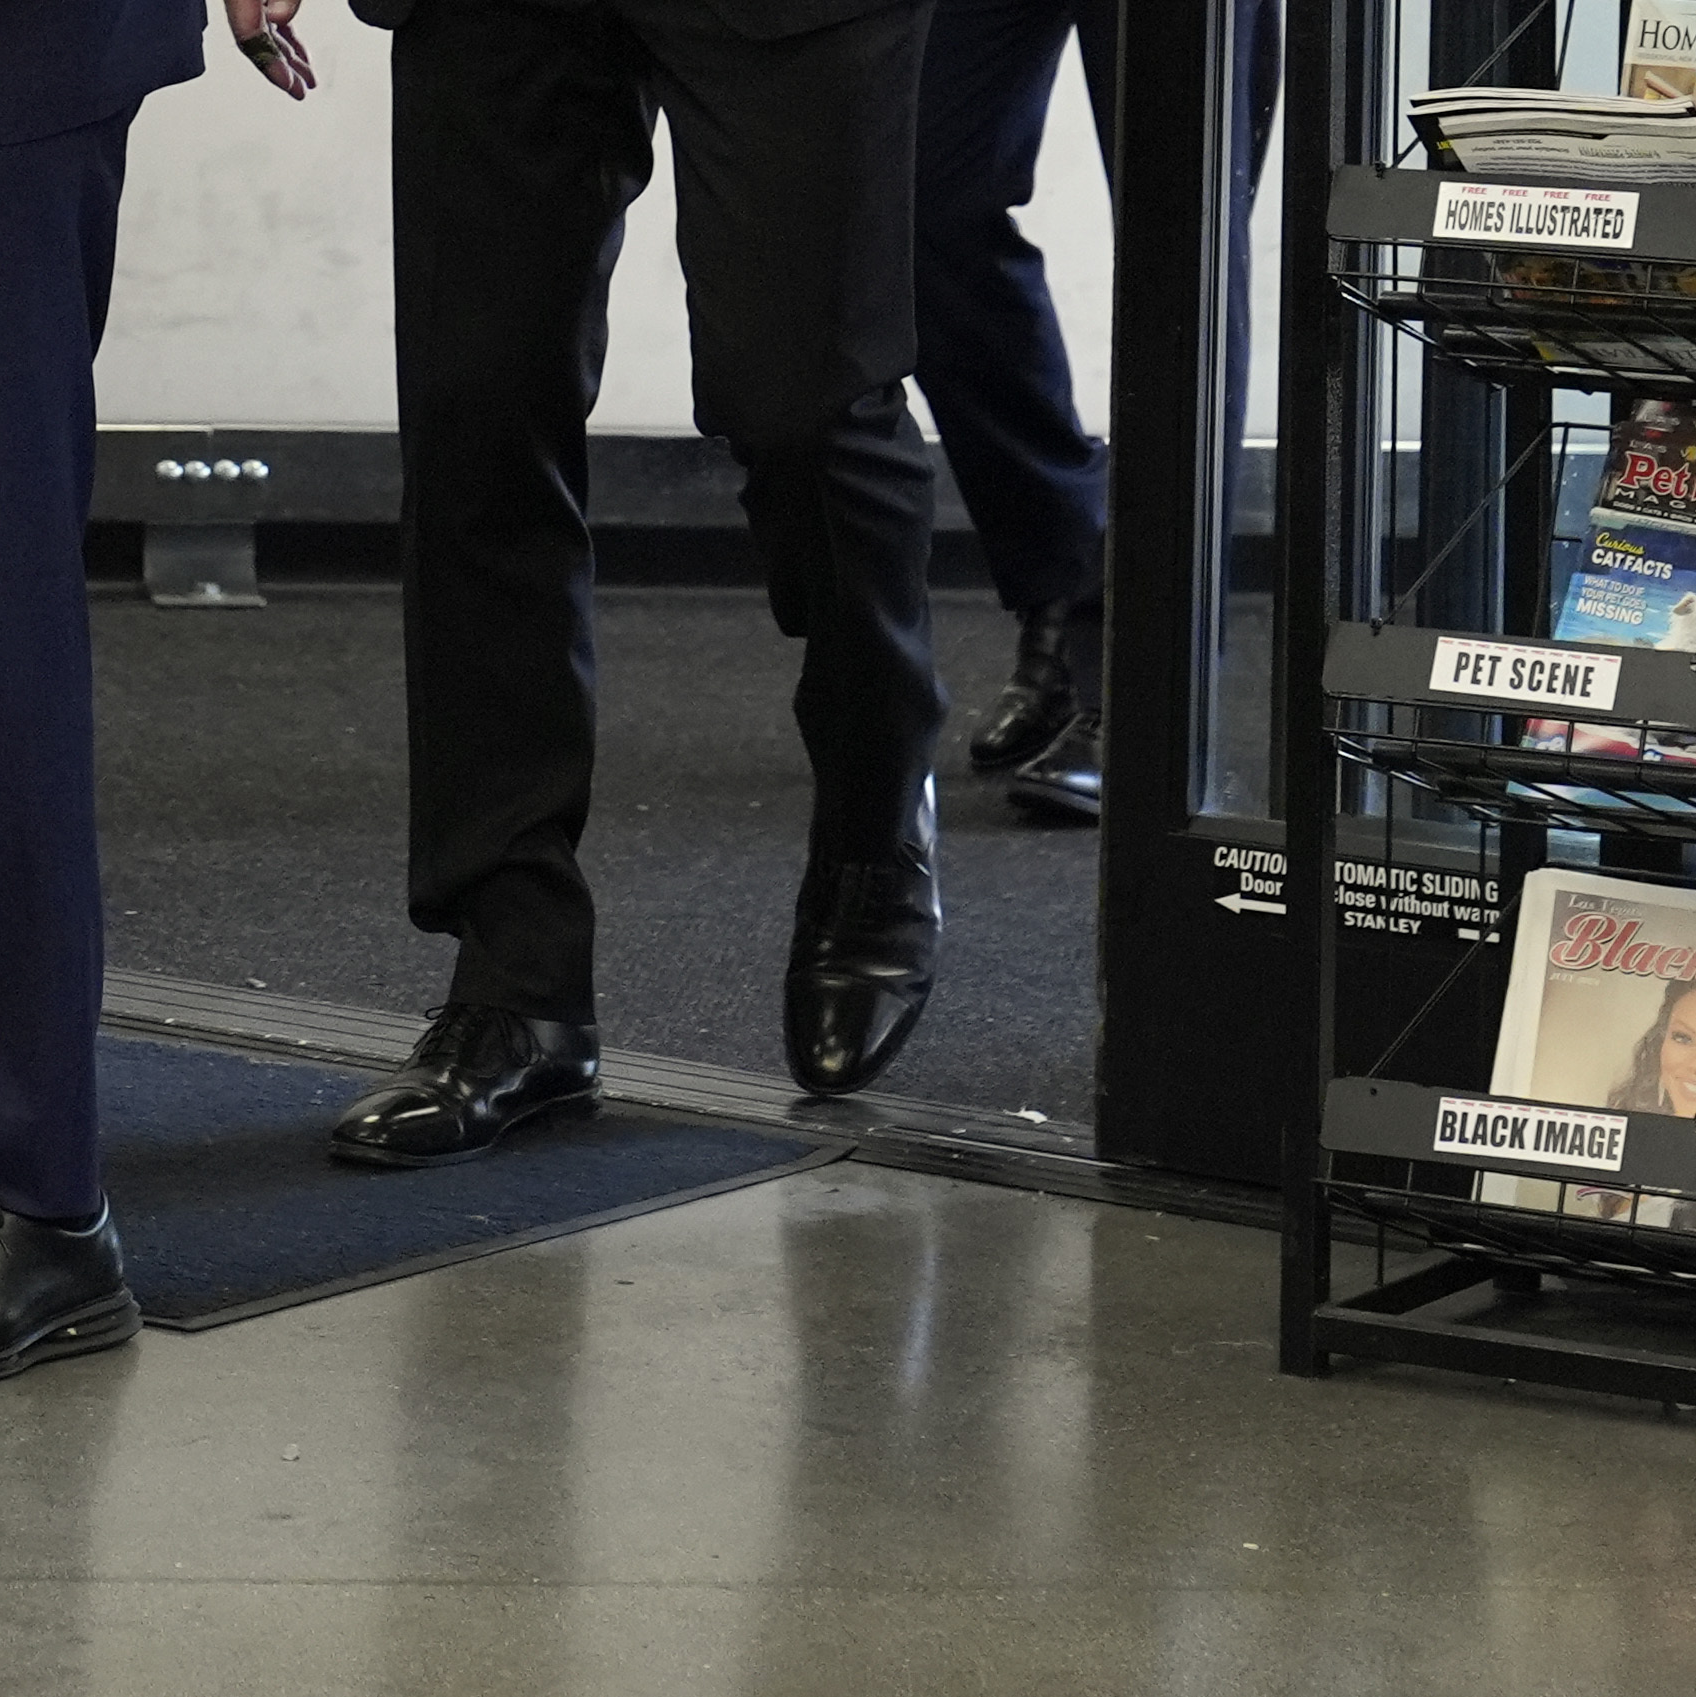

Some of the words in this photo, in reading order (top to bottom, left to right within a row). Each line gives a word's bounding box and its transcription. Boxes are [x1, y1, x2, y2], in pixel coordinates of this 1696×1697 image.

[1462, 186, 1487, 195] FREE
[1503, 188, 1528, 197] FREE
[1544, 190, 1569, 200] FREE
[1585, 192, 1611, 202] FREE
[1445, 200, 1505, 232] HOMES
[1510, 203, 1624, 240] ILLUSTRATED
[1629, 439, 1667, 453] LAS
[1617, 451, 1691, 498] Pet
[1596, 532, 1645, 554] Curious
[1592, 549, 1625, 569] CAT
[1623, 555, 1673, 579] FACTS
[1584, 575, 1609, 587] WHAT
[1610, 579, 1622, 591] TO
[1622, 583, 1635, 593] DO
[1582, 587, 1605, 601] YOUR
[1605, 593, 1622, 604] PET
[1622, 597, 1647, 609] GOES
[1576, 598, 1643, 624] MISSING
[1453, 652, 1502, 686] PET
[1509, 658, 1595, 697] SCENE
[1240, 872, 1284, 896] Door
[1422, 872, 1499, 903] SLIDING
[1344, 911, 1422, 934] STANLEY
[1439, 1110, 1529, 1150] BLACK
[1534, 1119, 1621, 1161] IMAGE
